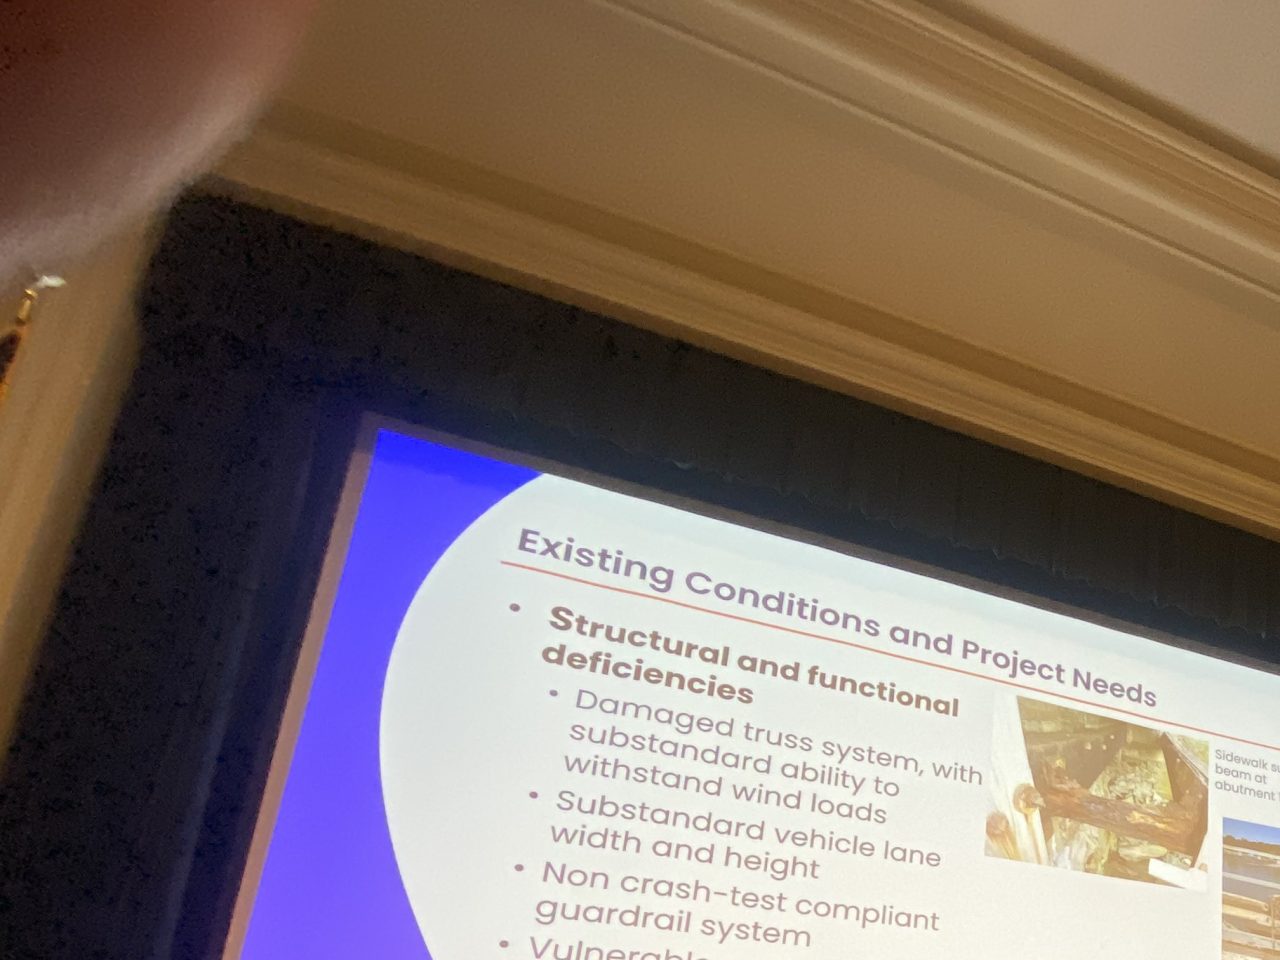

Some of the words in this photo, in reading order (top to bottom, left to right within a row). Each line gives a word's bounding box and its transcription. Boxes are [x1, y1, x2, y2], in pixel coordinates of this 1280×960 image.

[517, 528, 675, 593] Existing
[685, 571, 880, 637] Conditions
[890, 625, 953, 655] and
[962, 640, 1065, 684] Project
[1072, 668, 1157, 707] Needs
[541, 642, 755, 705] deficiencies
[548, 605, 729, 667] Structural
[737, 650, 800, 682] and
[807, 664, 960, 717] functional
[569, 722, 772, 774] substandard
[780, 758, 865, 797] ability
[873, 775, 900, 798] to
[575, 688, 734, 738] Damaged
[744, 721, 813, 753] truss
[821, 740, 925, 776] system,
[932, 760, 983, 785] with
[1214, 749, 1268, 771] Sidewalk
[563, 753, 723, 798] withstand
[731, 780, 801, 811] wind
[810, 792, 888, 825] loads
[1214, 763, 1252, 781] beam
[1254, 773, 1268, 784] at
[1214, 779, 1275, 802] abutment
[551, 824, 642, 855] width
[651, 838, 715, 865] and
[723, 845, 820, 881] height
[556, 790, 765, 841] Substandard
[774, 826, 875, 857] vehicle
[883, 840, 942, 867] lane
[535, 898, 692, 934] guardrail
[700, 916, 812, 948] system
[541, 861, 610, 891] Non
[620, 872, 787, 914] crash-test
[795, 897, 940, 932] compliant
